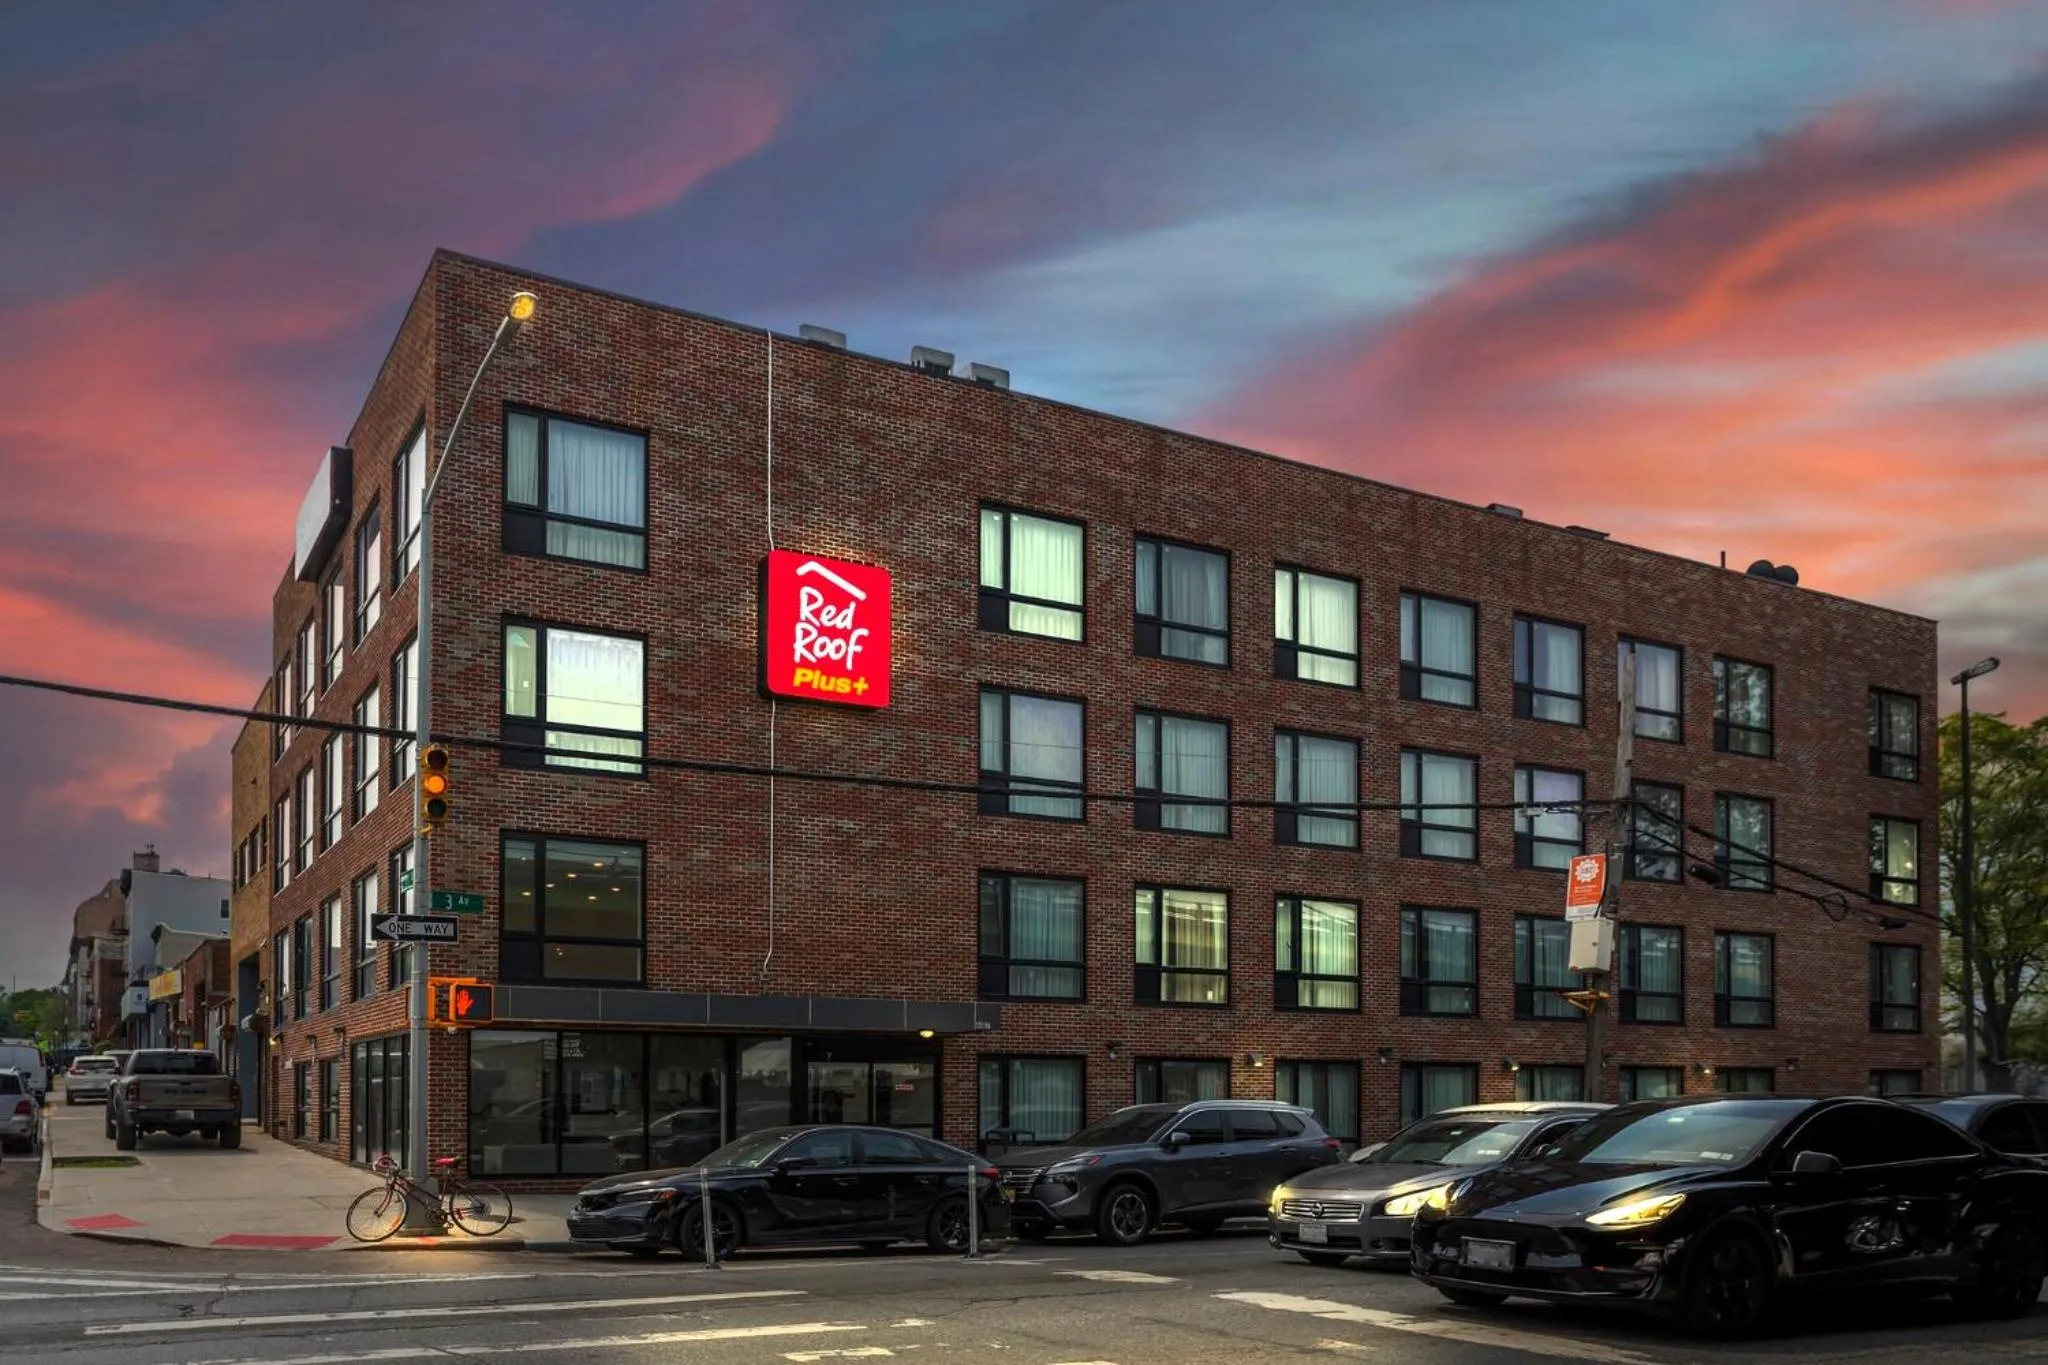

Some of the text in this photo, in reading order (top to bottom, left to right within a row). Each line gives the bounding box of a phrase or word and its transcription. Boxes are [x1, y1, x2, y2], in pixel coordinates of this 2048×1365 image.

[800, 586, 856, 630] Red
[794, 622, 869, 670] Roof
[794, 667, 869, 695] Plus+
[445, 894, 453, 910] 3
[388, 922, 449, 934] ONE WAY
